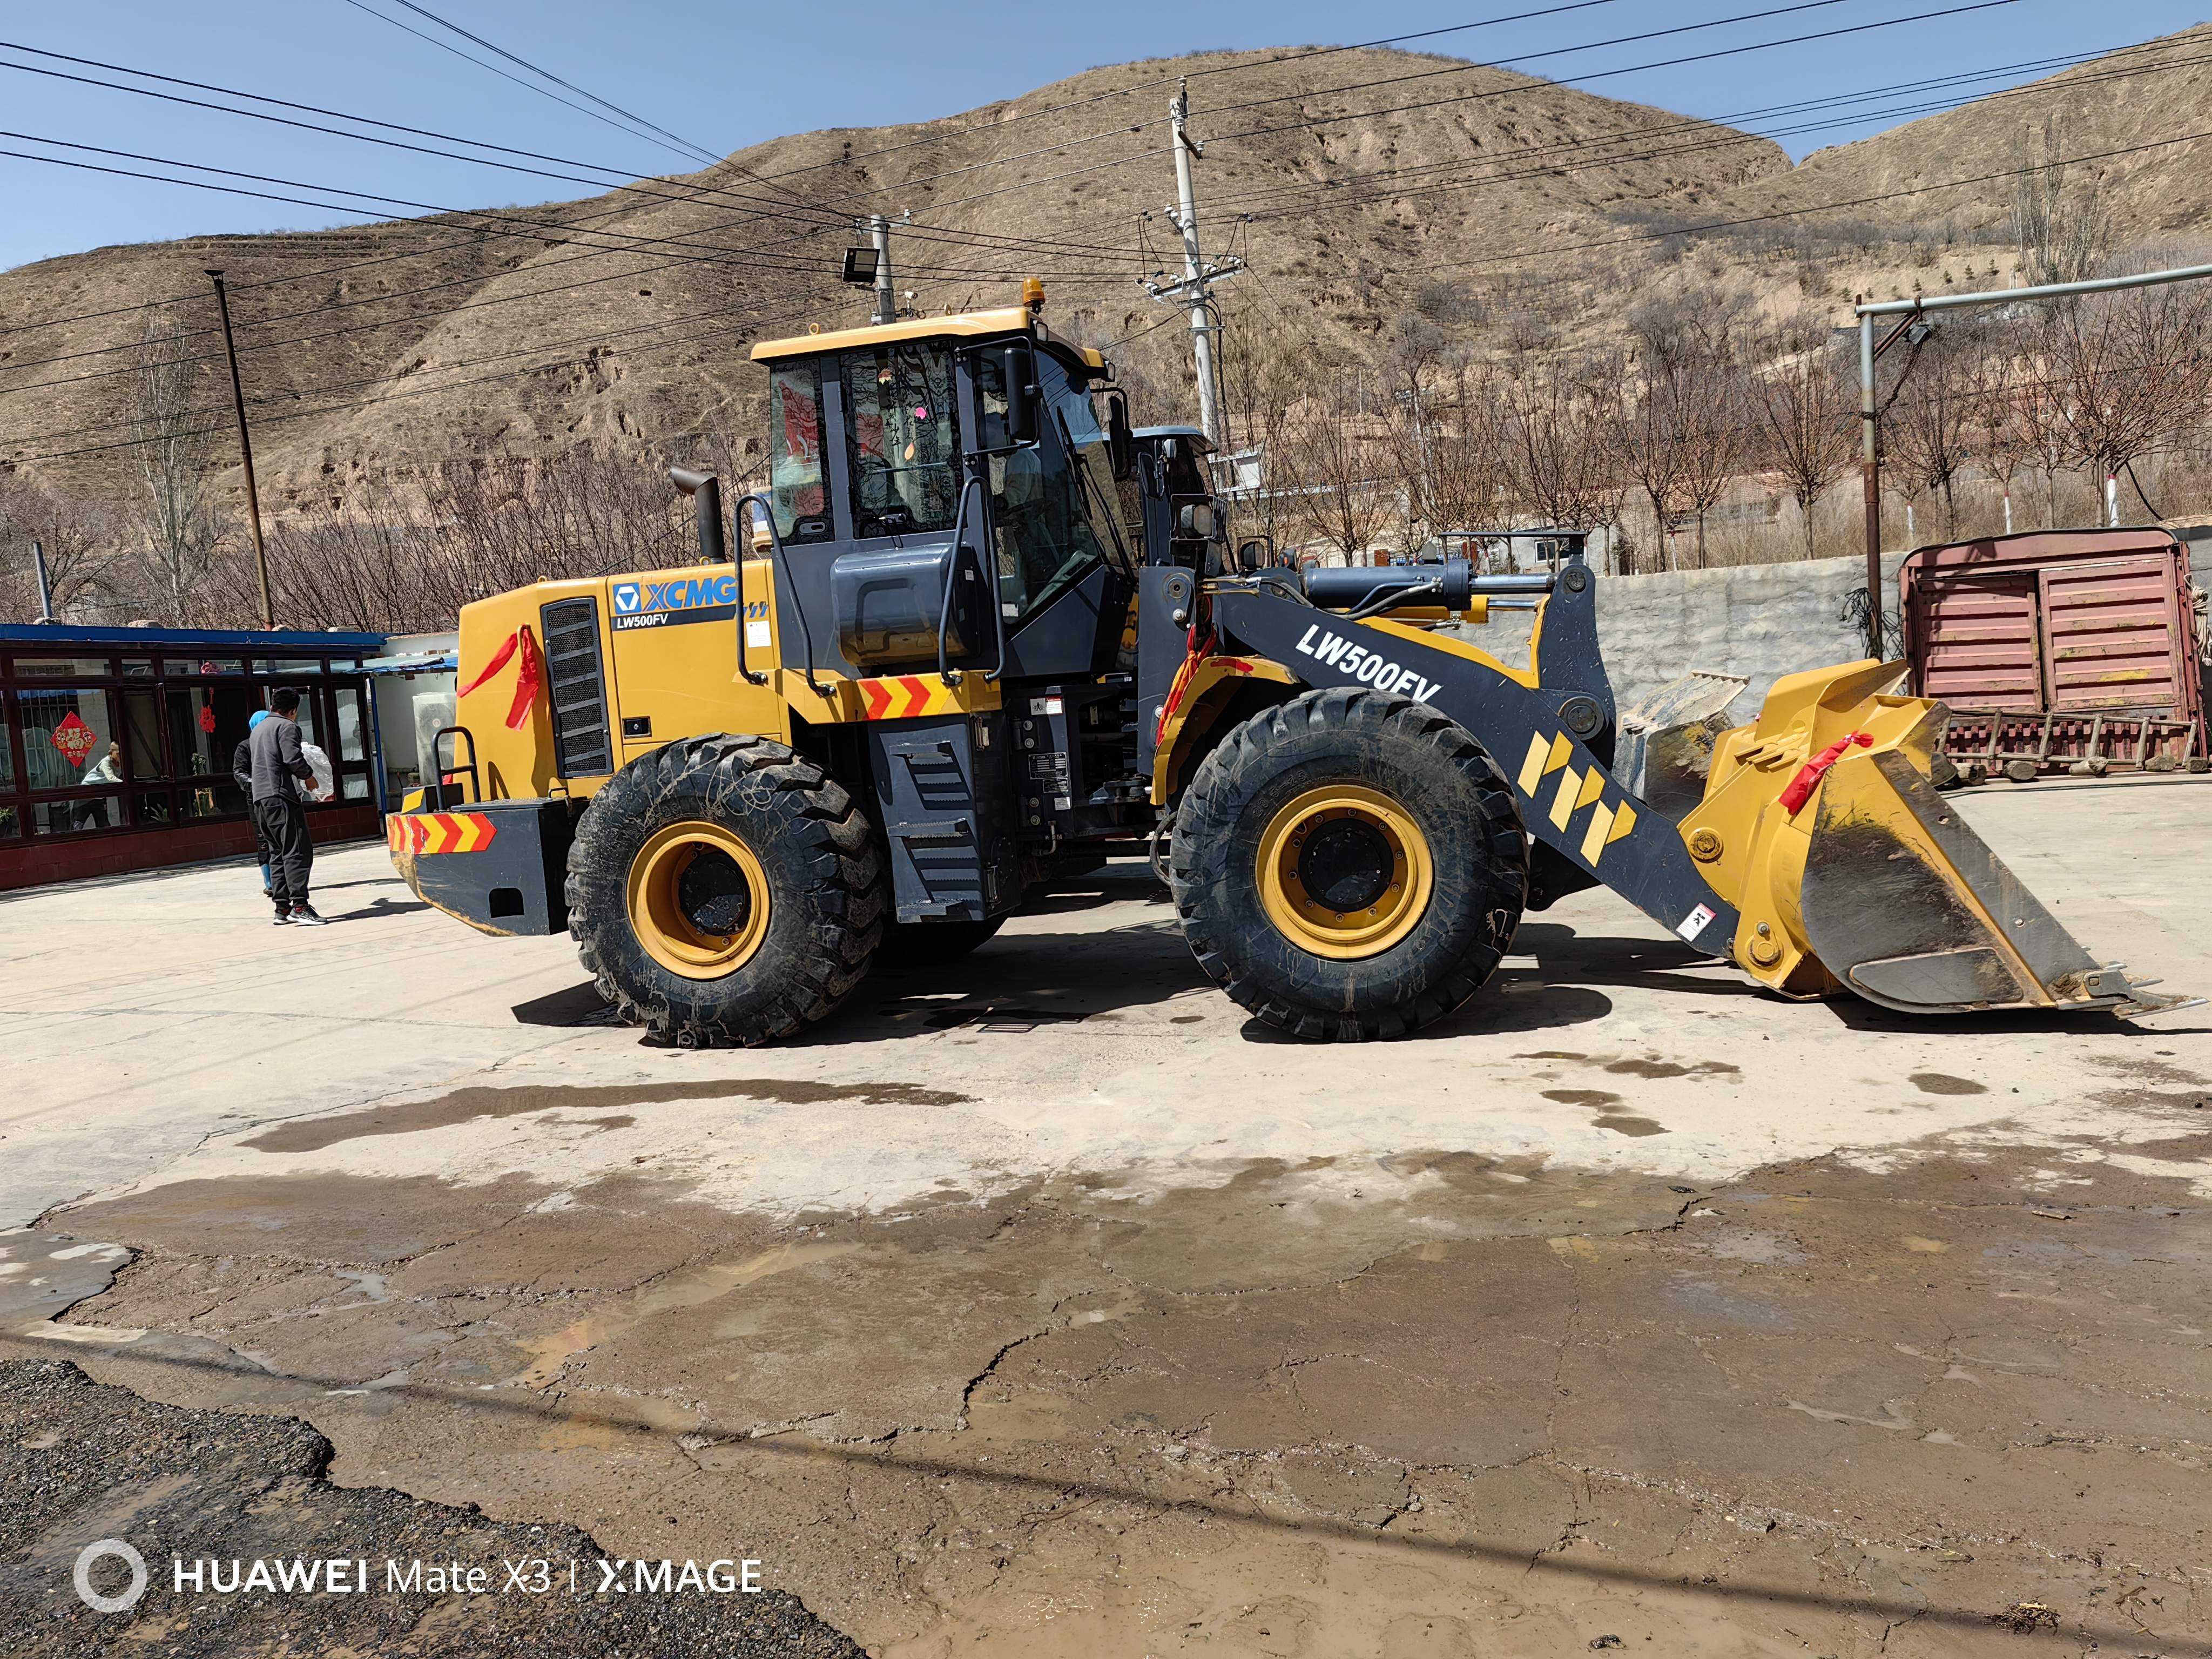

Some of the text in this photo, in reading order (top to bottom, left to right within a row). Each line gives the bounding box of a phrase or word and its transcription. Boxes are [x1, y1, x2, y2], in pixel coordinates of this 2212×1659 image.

[644, 576, 737, 611] XCMG
[617, 613, 669, 629] LW500FV
[1296, 624, 1443, 703] LW500FV
